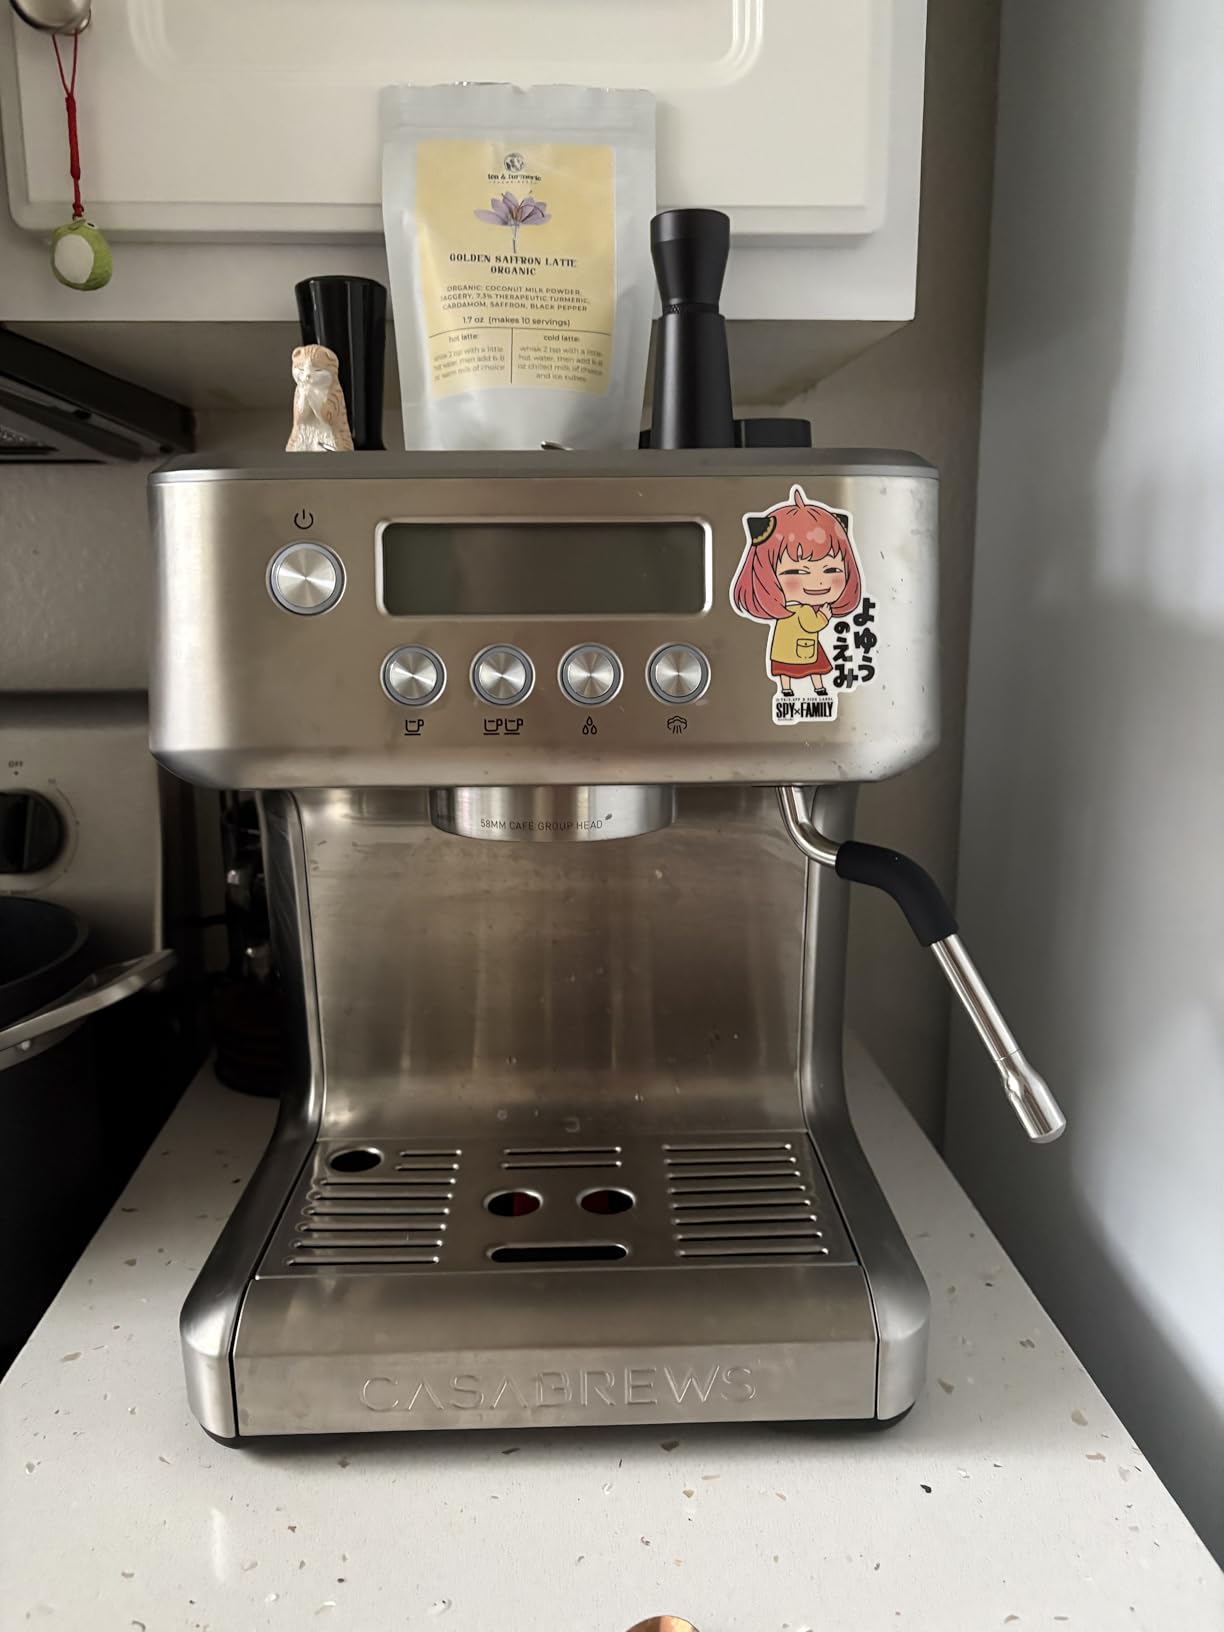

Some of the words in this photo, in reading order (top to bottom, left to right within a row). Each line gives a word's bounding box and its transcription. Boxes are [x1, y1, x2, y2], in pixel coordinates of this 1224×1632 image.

[450, 253, 491, 263] GOLDEN
[495, 255, 541, 265] SAFFRON
[545, 258, 577, 267] LATTE
[491, 266, 536, 275] ORGANIC
[488, 316, 520, 325] (makes
[532, 318, 571, 327] servings)
[853, 597, 877, 682] よゆう
[833, 621, 858, 688] のえみ
[480, 819, 506, 828] 58MM
[537, 821, 573, 831] GROUP
[576, 820, 603, 830] HEAD
